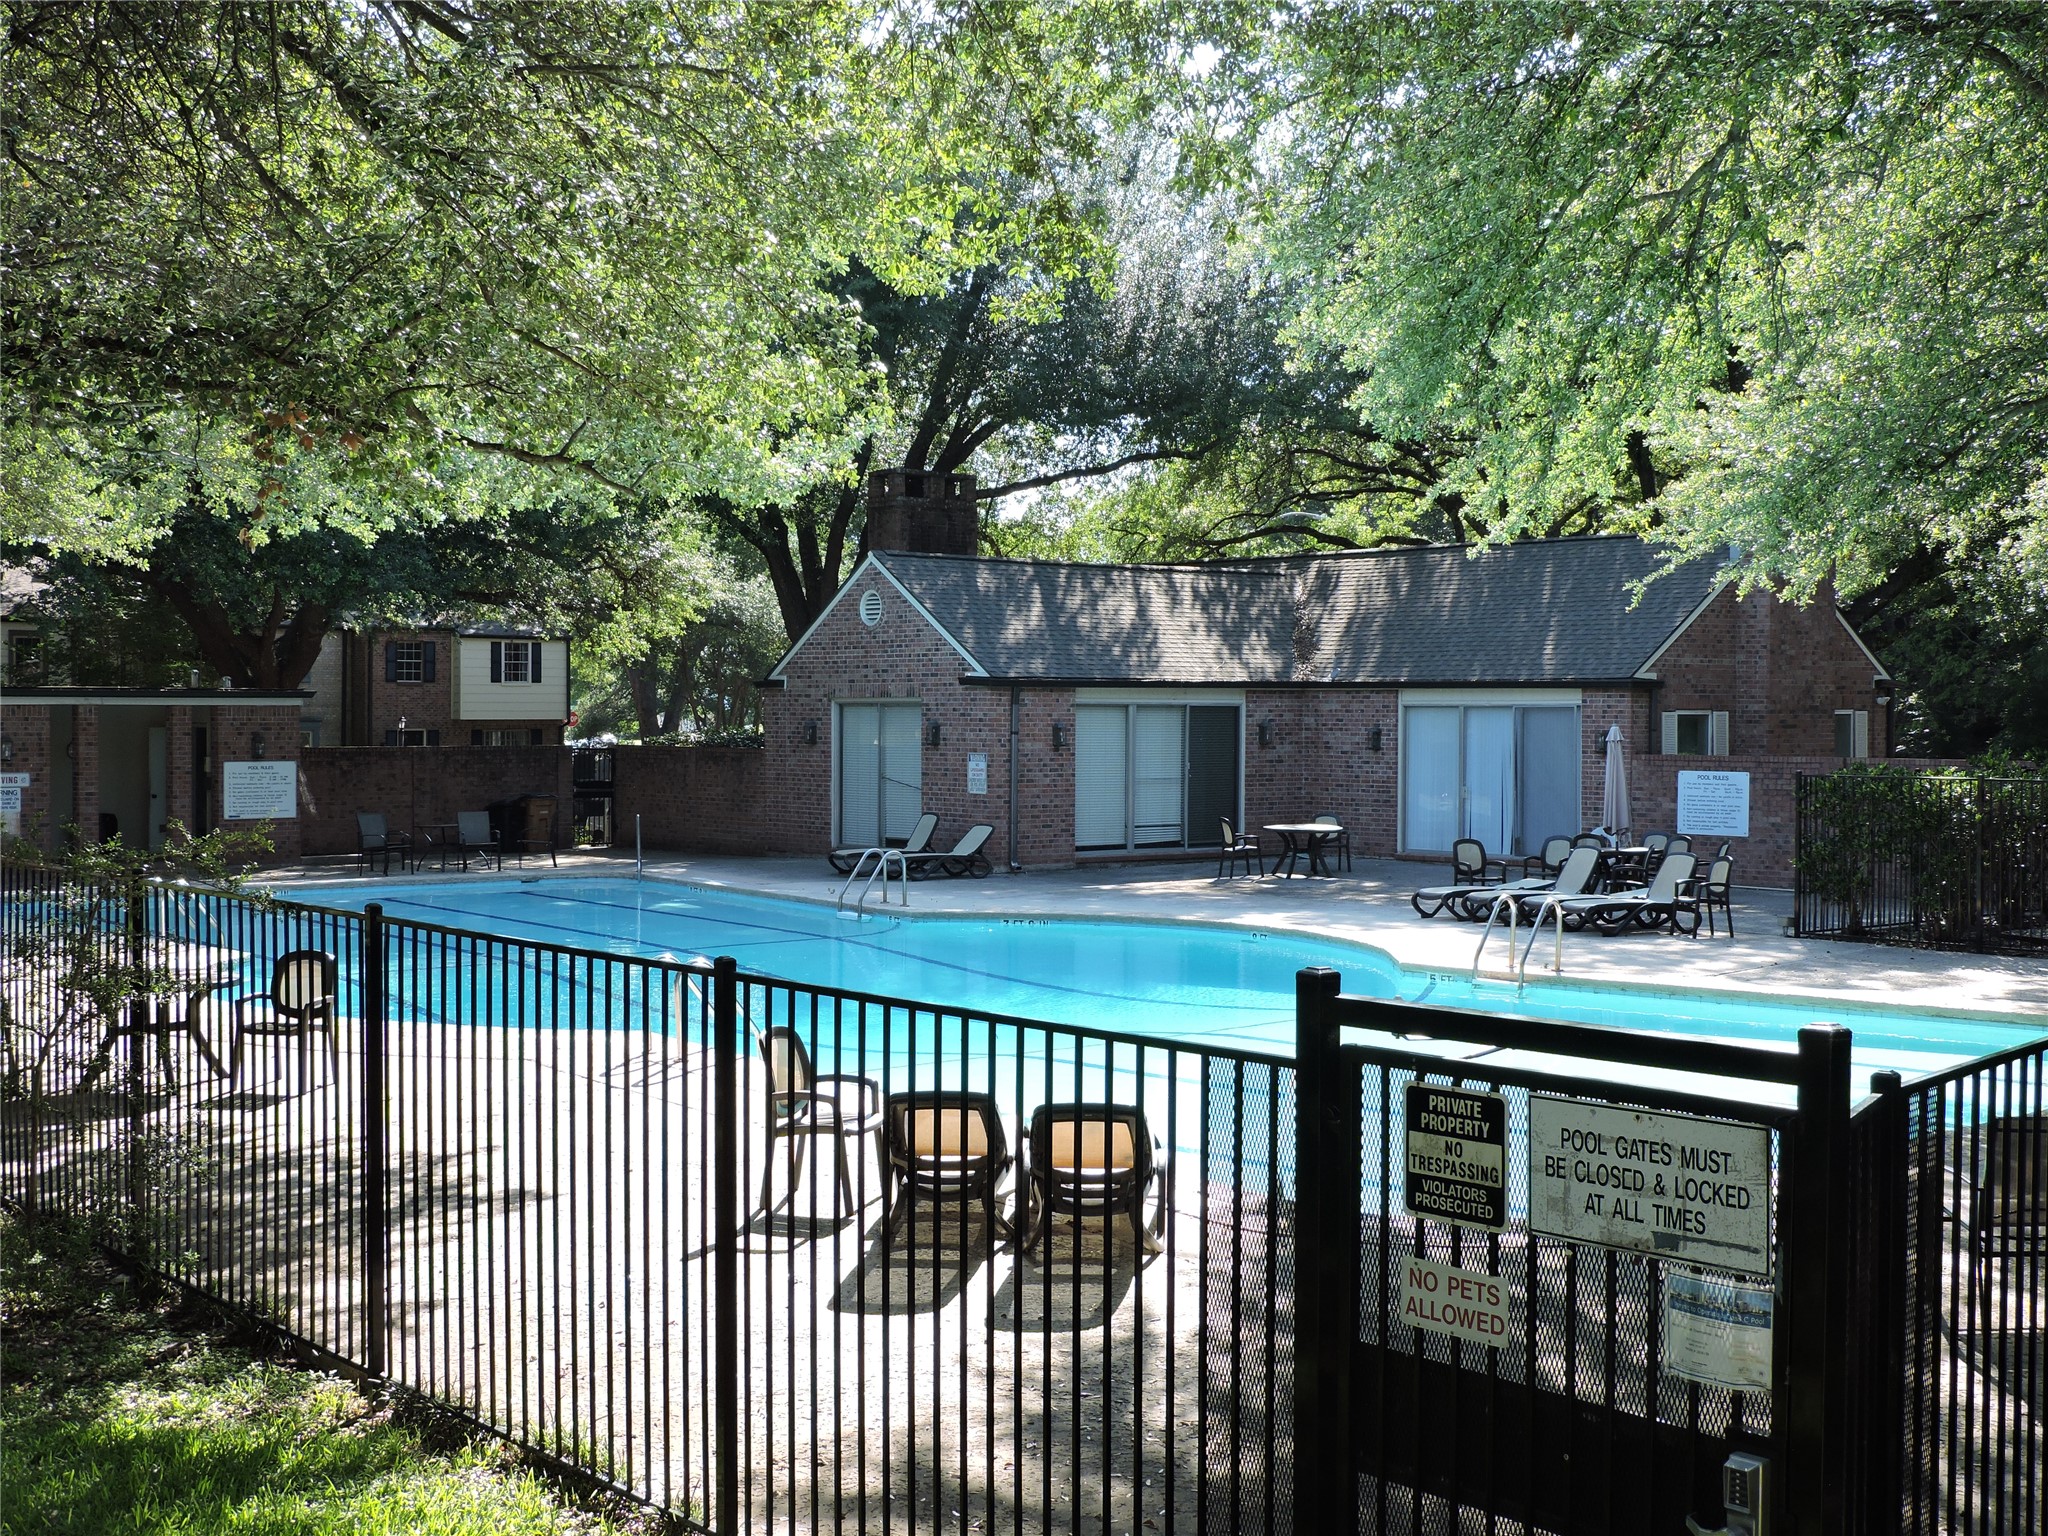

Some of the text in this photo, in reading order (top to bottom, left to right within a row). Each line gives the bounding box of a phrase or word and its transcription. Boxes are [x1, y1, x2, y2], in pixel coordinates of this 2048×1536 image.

[1428, 1094, 1482, 1118] PRIVATE
[1421, 1112, 1490, 1138] PROPERTY
[1444, 1140, 1463, 1158] NO
[1560, 1127, 1732, 1175] POOL GATES MUST
[1411, 1153, 1499, 1184] TRESPASSING
[1545, 1155, 1750, 1210] BE CLOSED & LOCKED
[1422, 1178, 1487, 1202] VIOLATORS
[1415, 1192, 1494, 1219] PROSECUTED
[1584, 1193, 1706, 1235] AT ALL TIMES
[1409, 1267, 1500, 1306] NO PETS
[1406, 1296, 1505, 1336] ALLOWED
[1750, 1317, 1765, 1325] Pool
